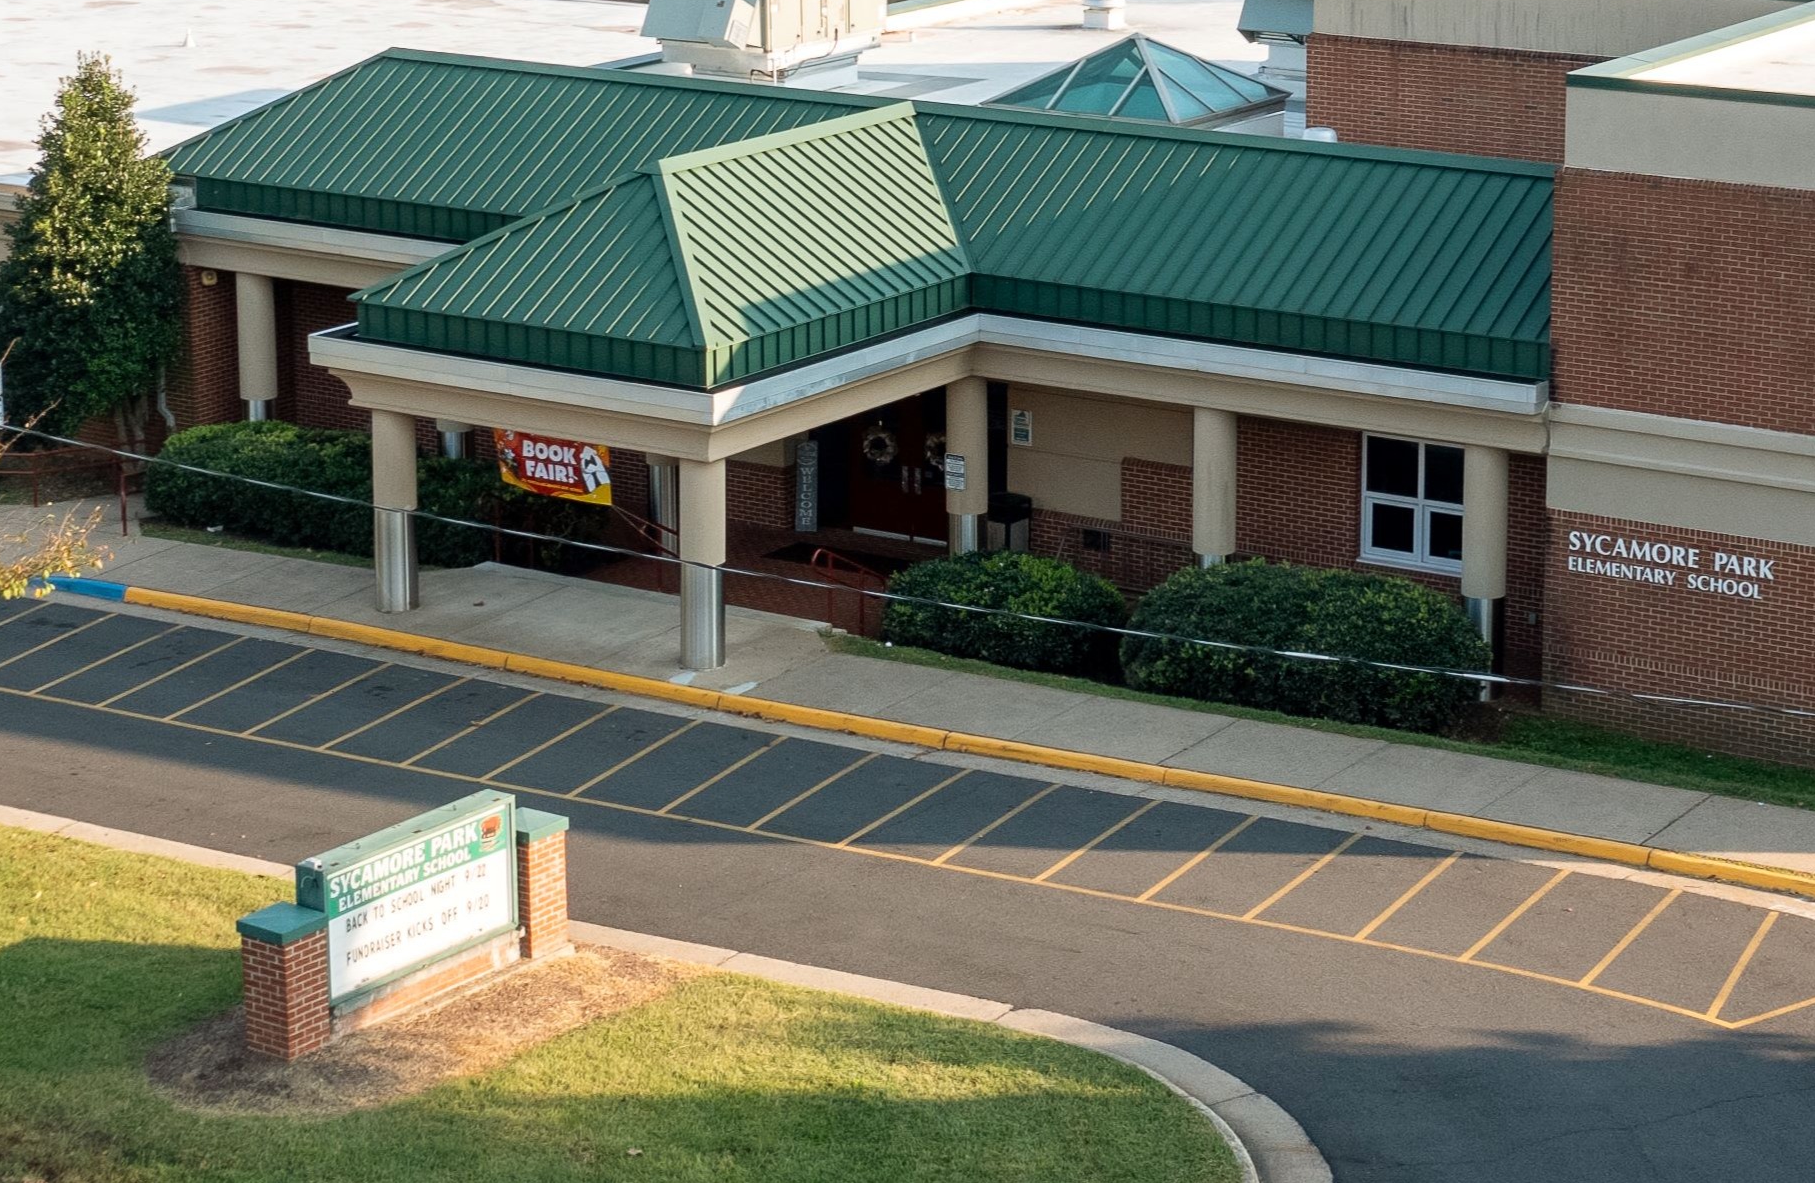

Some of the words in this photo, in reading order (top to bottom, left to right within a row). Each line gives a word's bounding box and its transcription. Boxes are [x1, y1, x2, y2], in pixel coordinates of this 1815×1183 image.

[522, 440, 577, 465] BOOK
[525, 460, 575, 483] FAIR!
[799, 467, 814, 525] WELCOME
[1568, 530, 1700, 568] SYCAMORE
[1714, 552, 1774, 580] PARK
[1568, 556, 1676, 585] ELEMENTARY
[1687, 573, 1762, 599] SCHOOL
[330, 842, 426, 899] SYCAMORE
[431, 822, 478, 857] PARK
[339, 868, 420, 911] ELEMENTARY
[424, 847, 471, 877] SCHOOL
[346, 911, 368, 933] BACK
[373, 905, 384, 919] TO
[391, 889, 424, 914] SCHOOL
[431, 874, 456, 896] NIGHT
[464, 863, 487, 882] 9/22
[346, 931, 402, 966] FUNDRAISER
[407, 917, 434, 938] KICKS
[441, 907, 458, 925] OFF
[466, 894, 490, 913] 9/20
